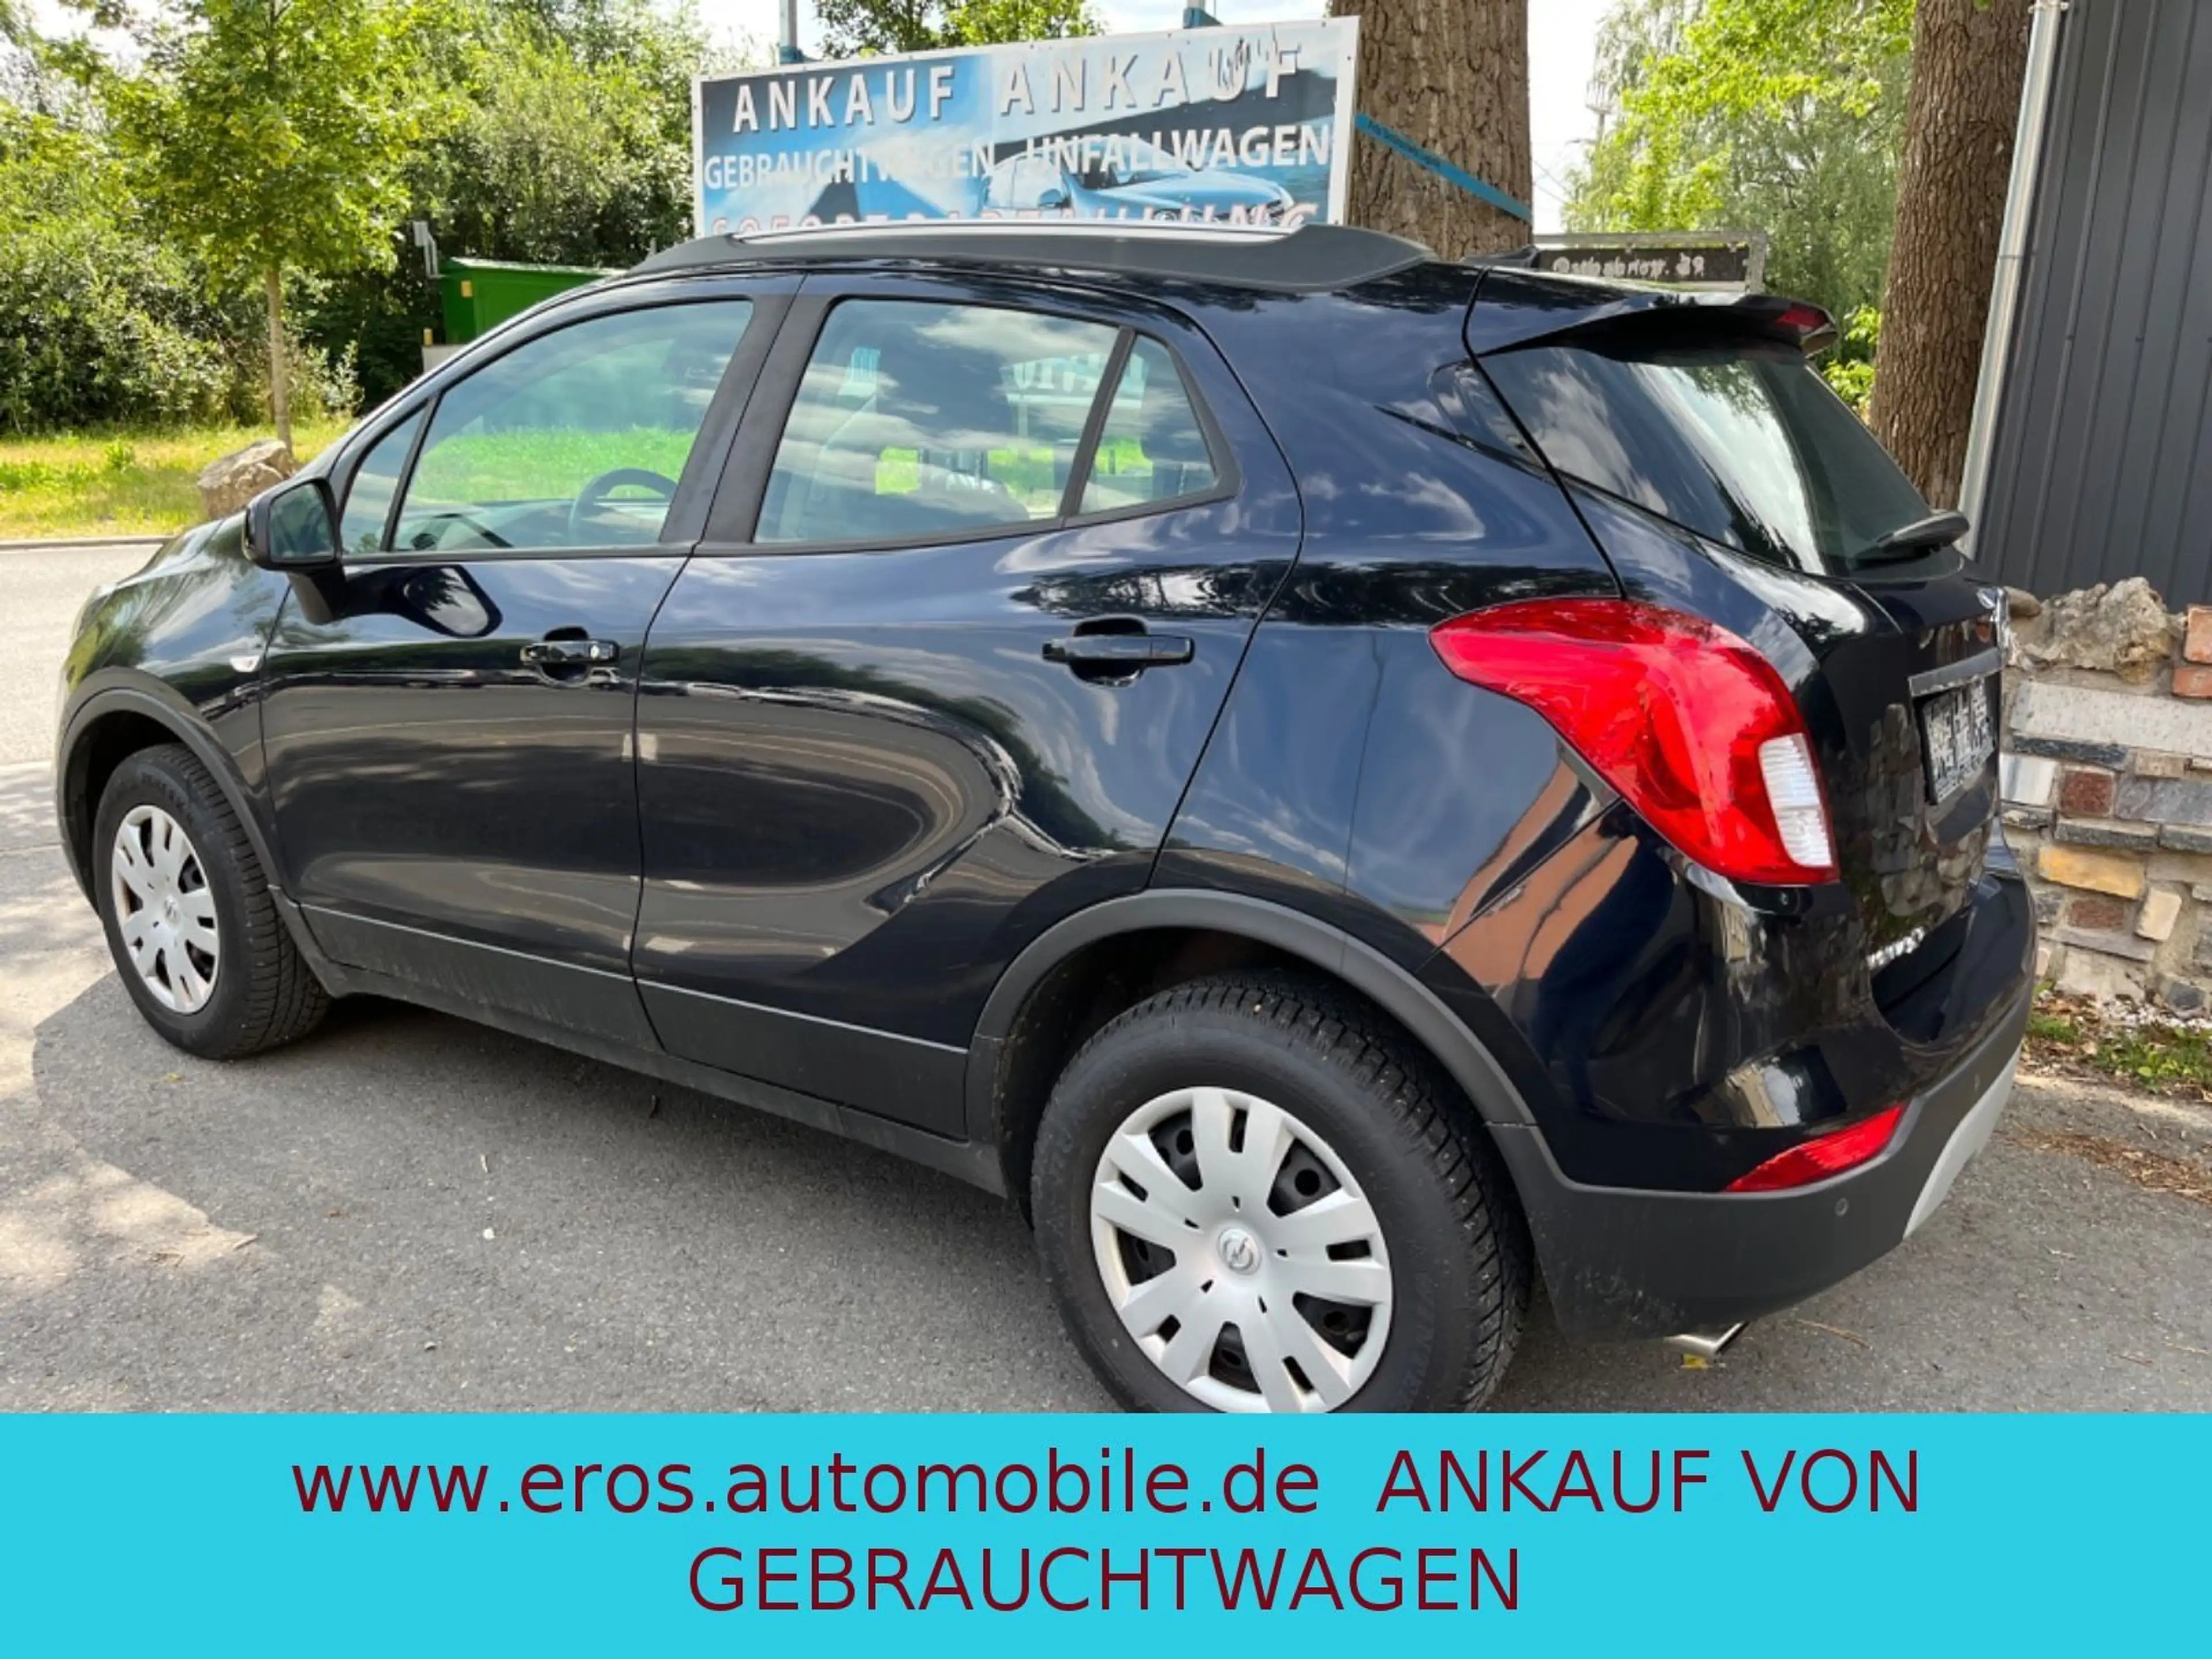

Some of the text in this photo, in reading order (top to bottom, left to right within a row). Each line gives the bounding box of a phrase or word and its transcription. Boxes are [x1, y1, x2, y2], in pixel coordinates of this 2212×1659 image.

[732, 38, 1300, 134] ANKAUF ANKAUF
[704, 141, 995, 190] GEBRAUCHTWGEN
